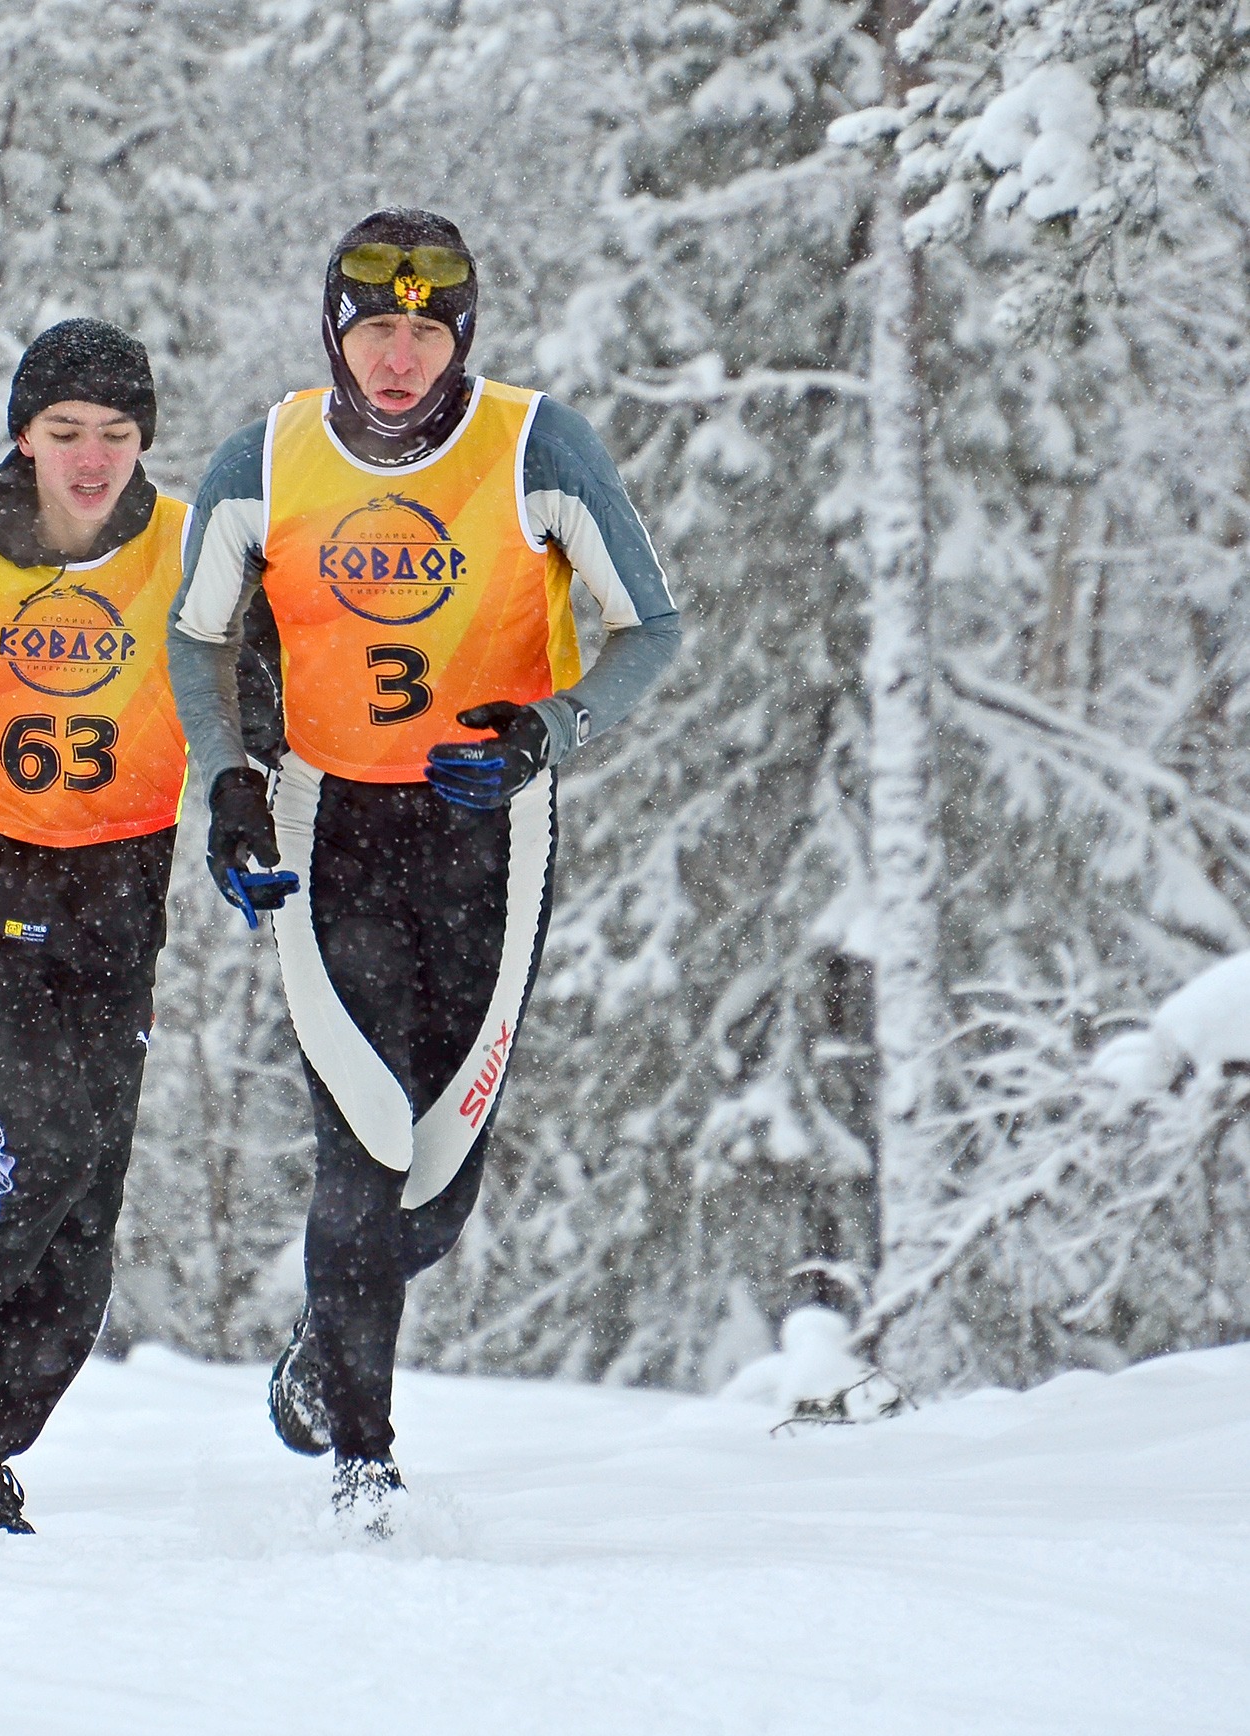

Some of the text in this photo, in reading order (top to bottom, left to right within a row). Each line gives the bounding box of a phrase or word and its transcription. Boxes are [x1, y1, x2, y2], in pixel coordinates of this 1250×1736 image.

[319, 545, 467, 581] КОВДОР
[366, 643, 434, 727] 3
[0, 713, 120, 795] 63
